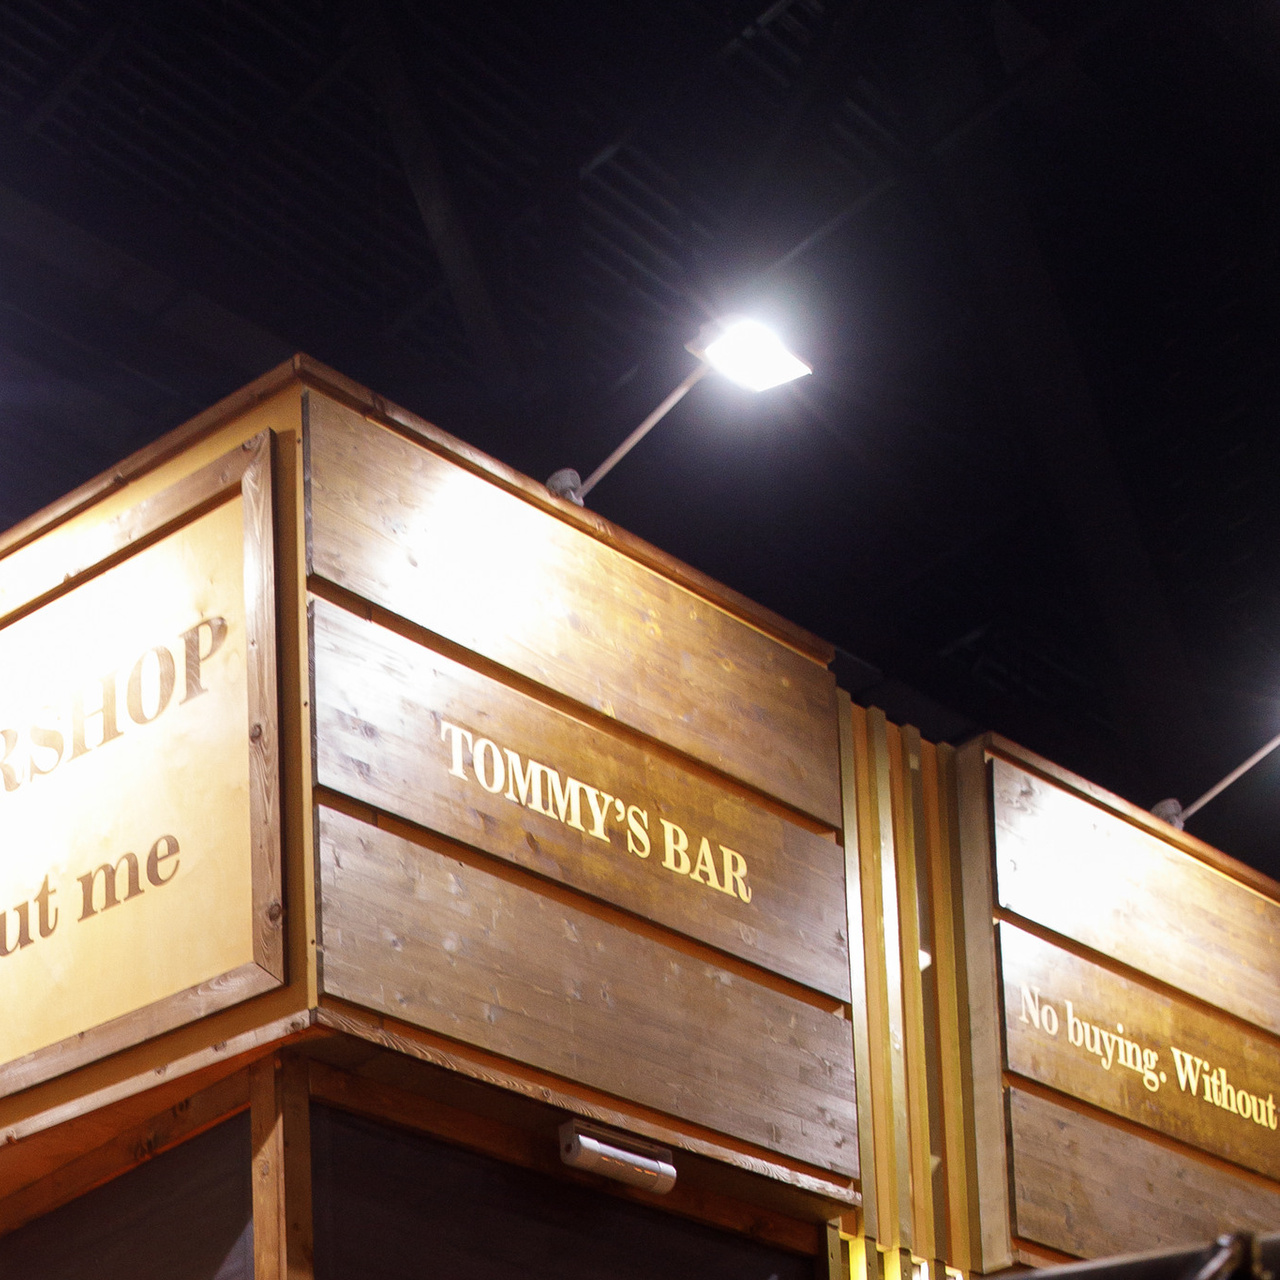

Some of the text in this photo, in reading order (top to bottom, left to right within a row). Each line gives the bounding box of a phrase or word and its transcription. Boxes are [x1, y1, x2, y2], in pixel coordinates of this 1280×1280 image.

[77, 833, 181, 923] me
[441, 721, 752, 904] TOMMY'S BAR
[1019, 981, 1279, 1130] No buying. Without
